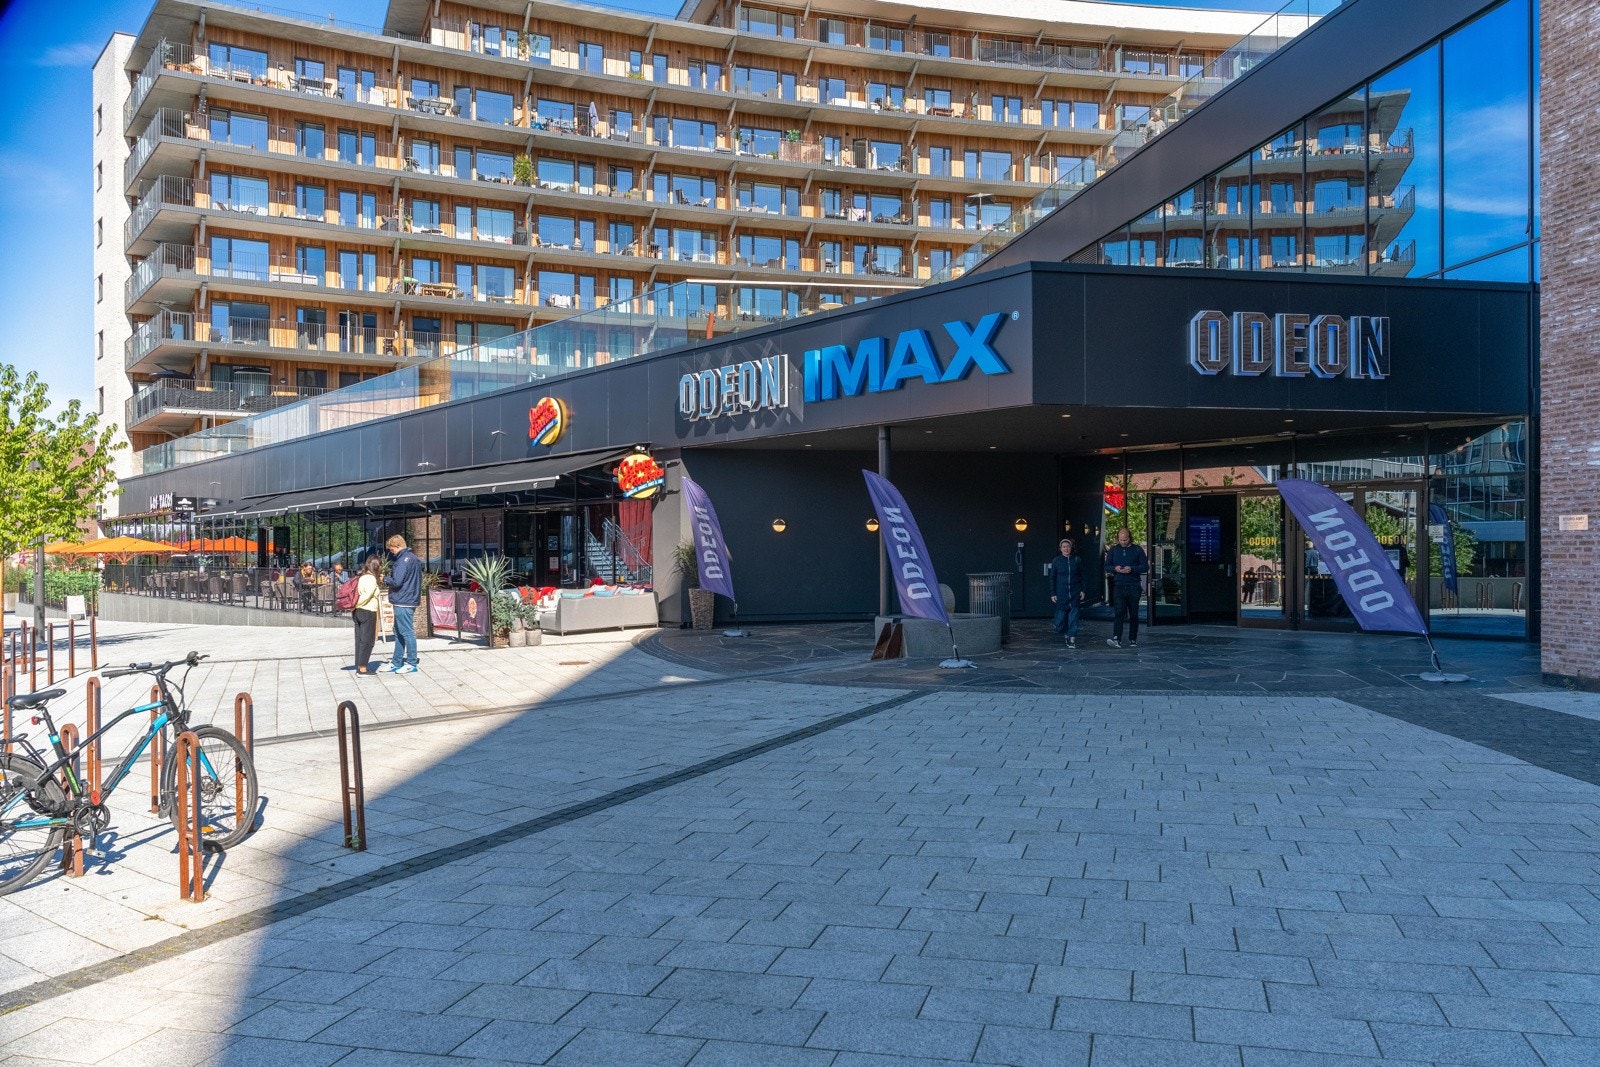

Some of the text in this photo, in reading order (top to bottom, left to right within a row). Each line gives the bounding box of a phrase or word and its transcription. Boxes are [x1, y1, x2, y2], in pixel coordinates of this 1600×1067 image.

[804, 312, 1013, 402] IMAX
[1190, 310, 1391, 379] ODEON
[679, 354, 789, 422] ODEON
[1249, 536, 1277, 546] ODEON
